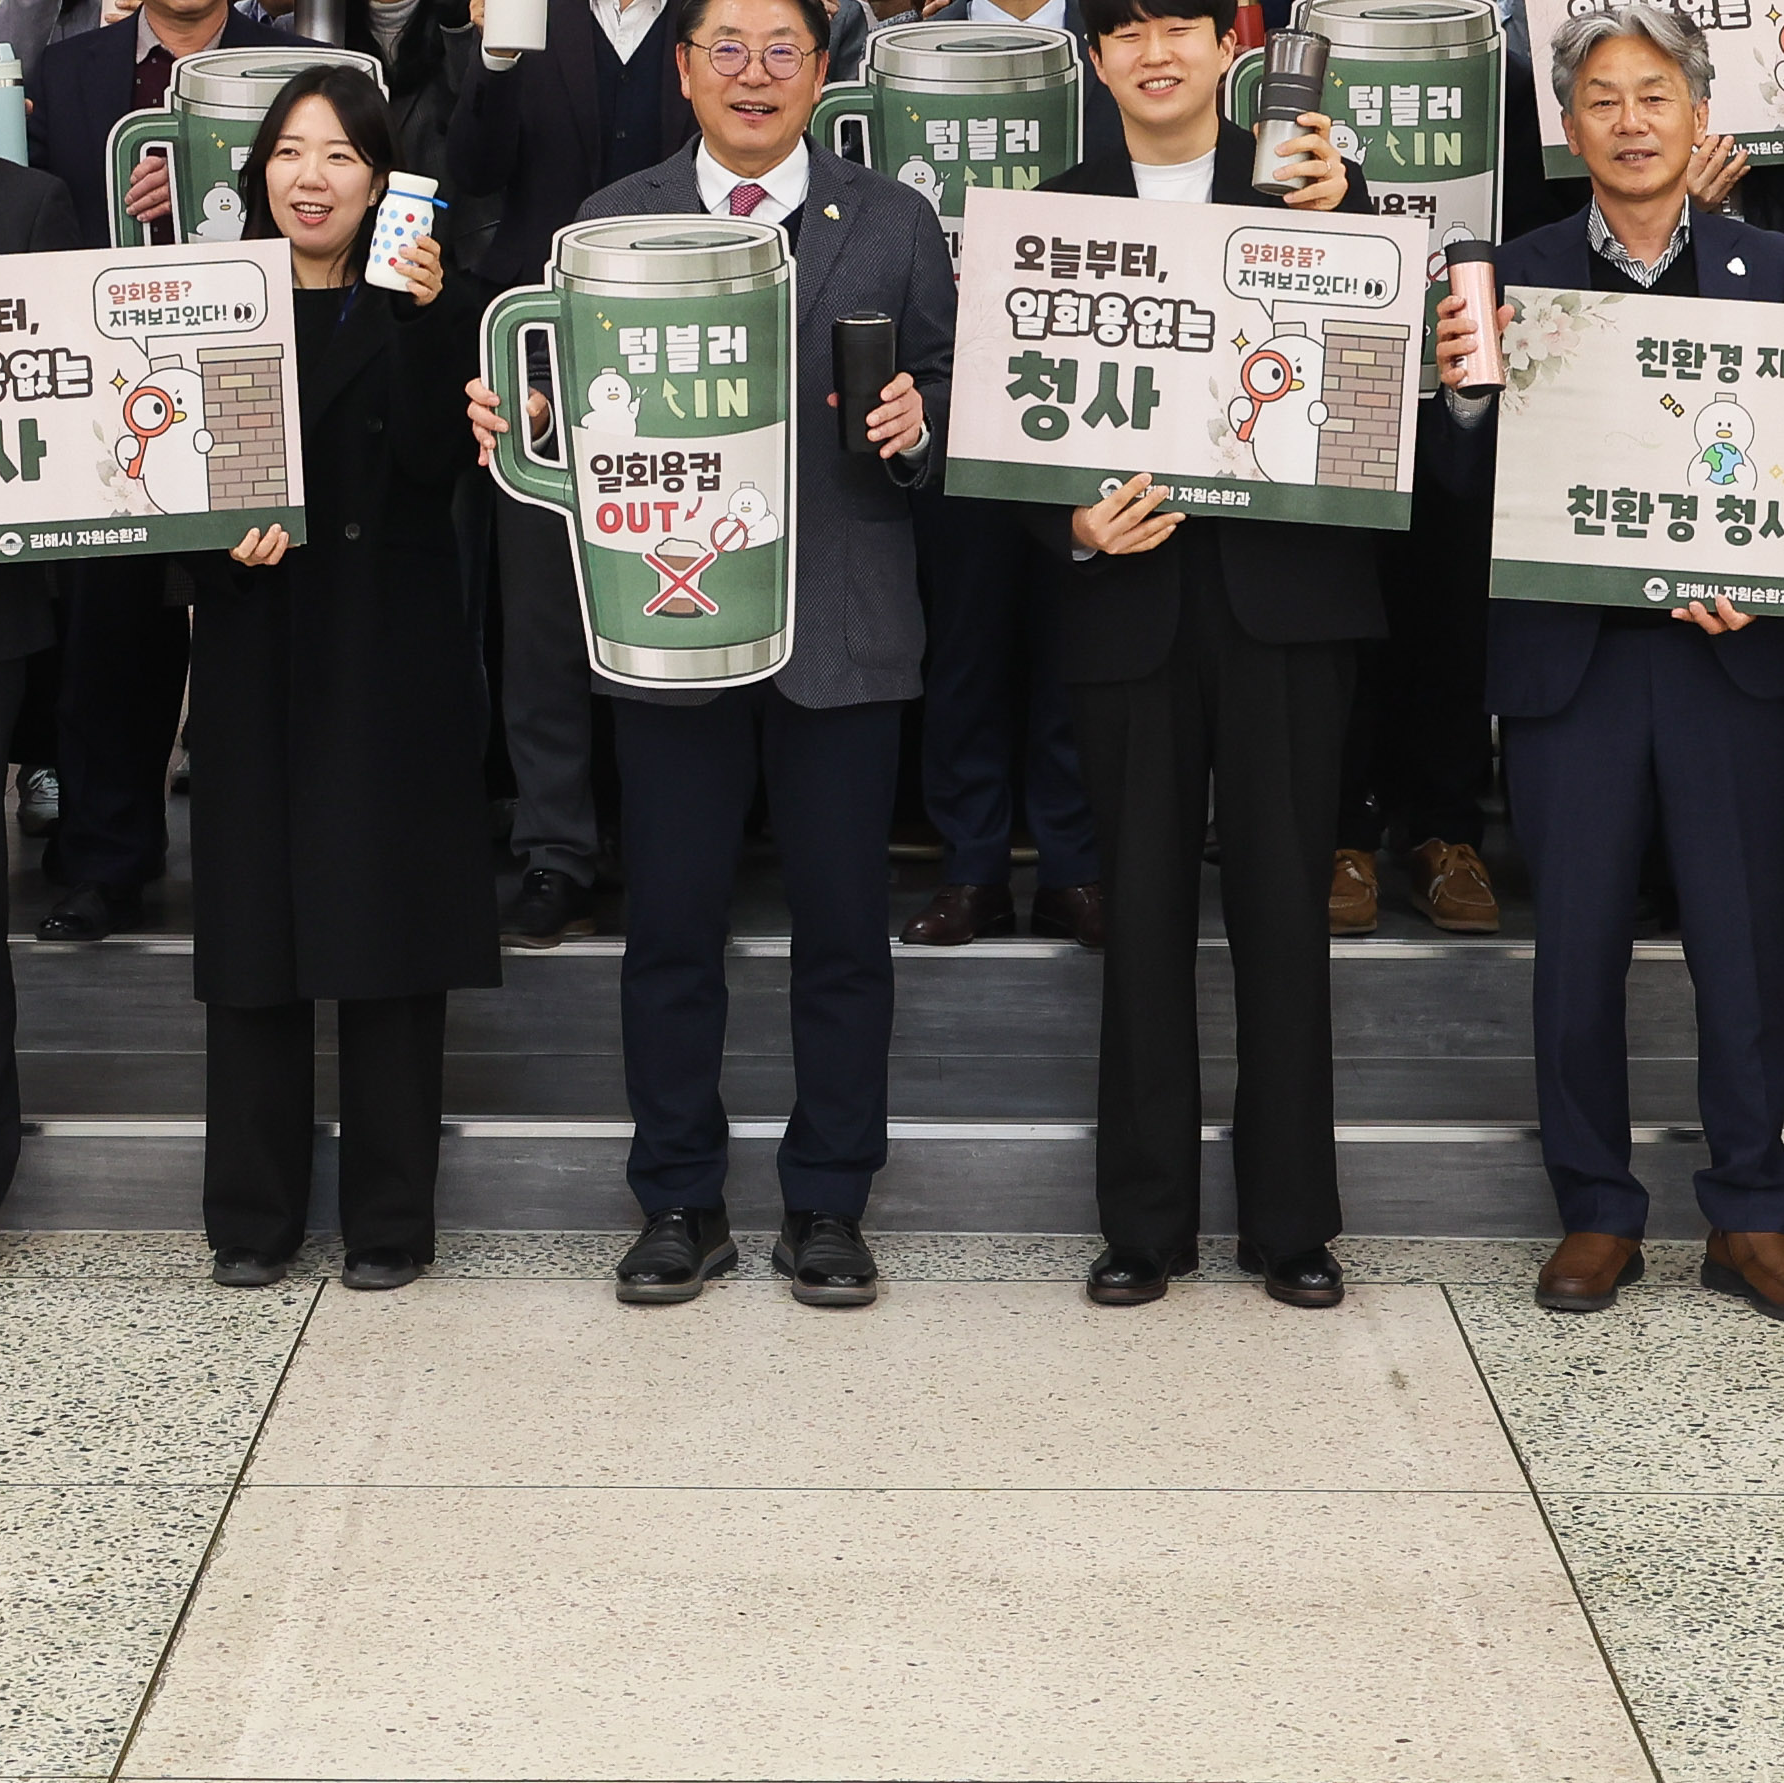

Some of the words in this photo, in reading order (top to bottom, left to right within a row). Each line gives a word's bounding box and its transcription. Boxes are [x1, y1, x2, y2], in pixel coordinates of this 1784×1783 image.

[1348, 84, 1463, 127] 텀블러
[925, 118, 1040, 161] 텀블러
[1413, 131, 1463, 166] IN
[1014, 235, 1169, 284] 오늘부터,
[1240, 242, 1326, 269] 일회용품?
[107, 279, 193, 306] 일회용품?
[1237, 269, 1359, 297] 지켜보고있다!
[109, 303, 228, 329] 지켜보고있다!
[1005, 286, 1216, 353] 일회용없는
[618, 324, 748, 374] 텀블러
[1635, 337, 1743, 384] 친환경
[693, 378, 749, 418] IN
[1005, 350, 1161, 442] 청사
[590, 451, 722, 494] 일회용컵
[1178, 486, 1251, 508] 자원순환과
[1566, 484, 1699, 543] 친환경
[596, 501, 679, 534] OUT
[29, 530, 73, 550] 김해시
[76, 526, 148, 547] 자원순환과
[1675, 582, 1719, 601] 김해시
